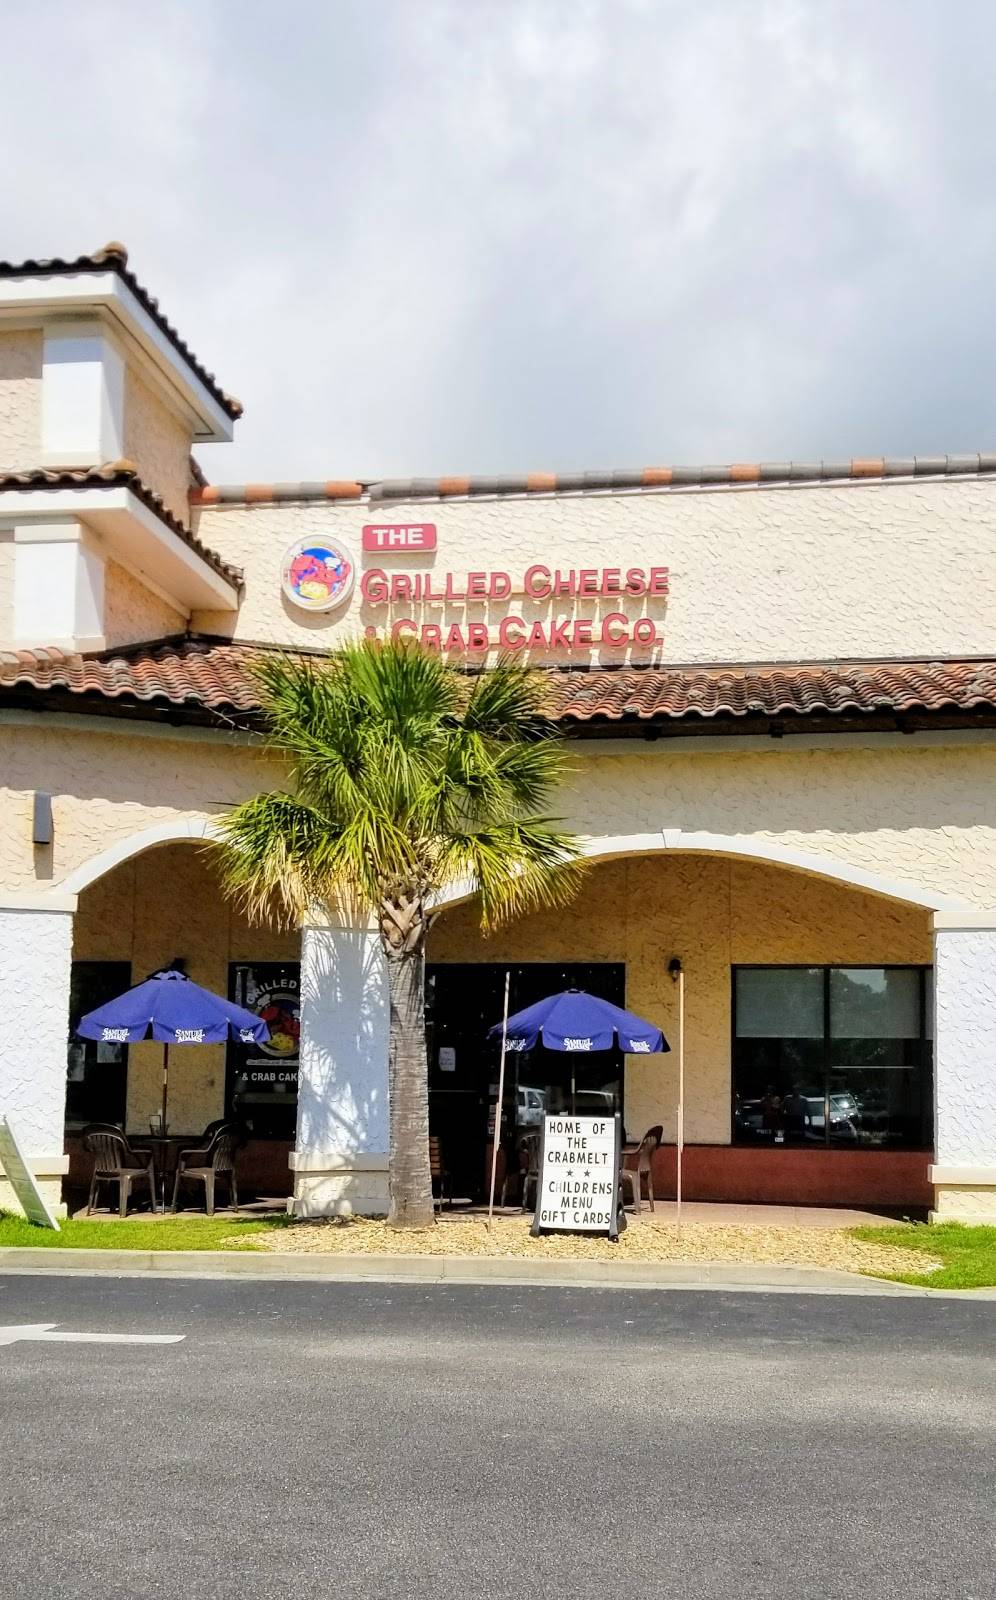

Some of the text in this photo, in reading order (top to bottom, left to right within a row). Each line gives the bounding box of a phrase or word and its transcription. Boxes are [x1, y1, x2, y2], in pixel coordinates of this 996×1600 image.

[372, 528, 424, 545] THE
[360, 564, 670, 602] GRILLED CHEESE
[391, 619, 489, 651] CRAB
[499, 616, 594, 650] CAKE
[601, 612, 664, 649] CO.
[246, 979, 297, 1005] GRILLED
[242, 1072, 299, 1081] & CRAB CAK
[549, 1122, 606, 1135] HOME OF
[567, 1137, 587, 1149] THE
[548, 1152, 608, 1165] CRABMELT
[549, 1181, 612, 1195] CHILDRENS
[561, 1196, 593, 1209] MENU
[541, 1210, 611, 1224] GIFT CARDS
